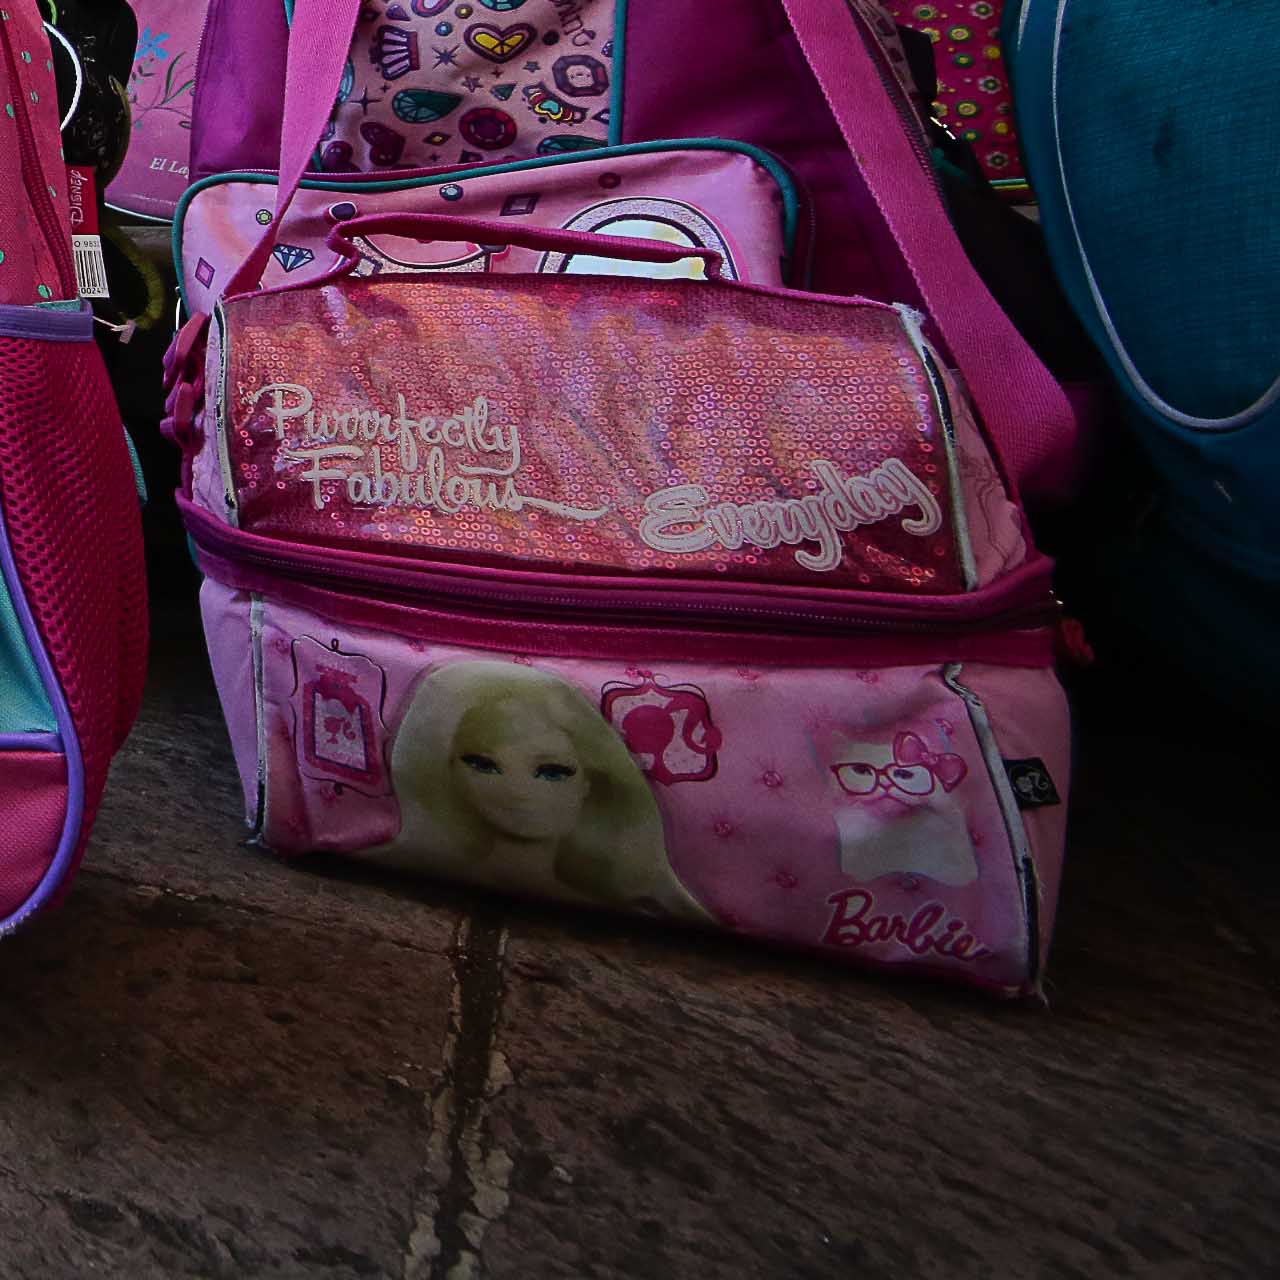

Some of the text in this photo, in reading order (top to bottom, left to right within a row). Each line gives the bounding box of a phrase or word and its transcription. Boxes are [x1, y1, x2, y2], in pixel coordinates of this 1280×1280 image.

[149, 157, 167, 171] El
[284, 444, 609, 521] Fabulous
[639, 457, 943, 572] Everyday
[822, 887, 991, 962] Barbie
